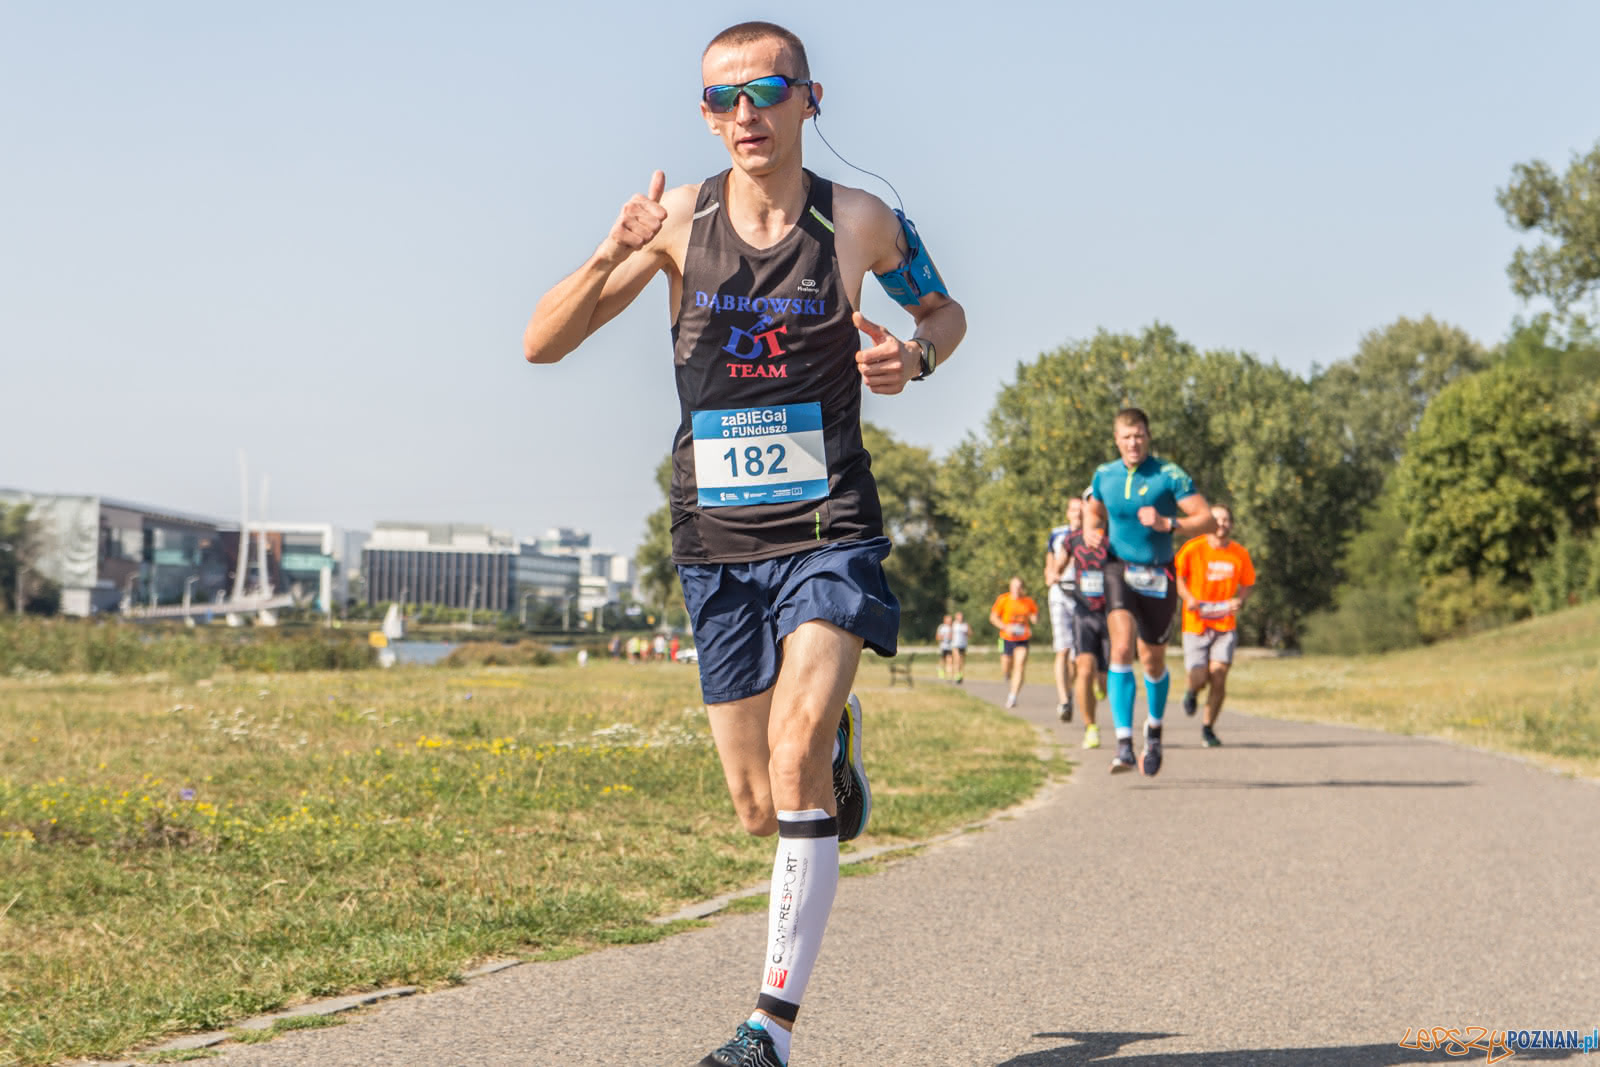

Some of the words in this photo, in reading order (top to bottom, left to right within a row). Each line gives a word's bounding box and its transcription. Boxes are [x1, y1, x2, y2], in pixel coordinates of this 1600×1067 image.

[695, 291, 826, 316] DĄBROWSKI
[722, 324, 788, 360] DT
[726, 363, 788, 378] TEAM
[721, 408, 787, 426] zaBIEGaj
[732, 424, 788, 437] FUNdusze
[723, 443, 788, 478] 182
